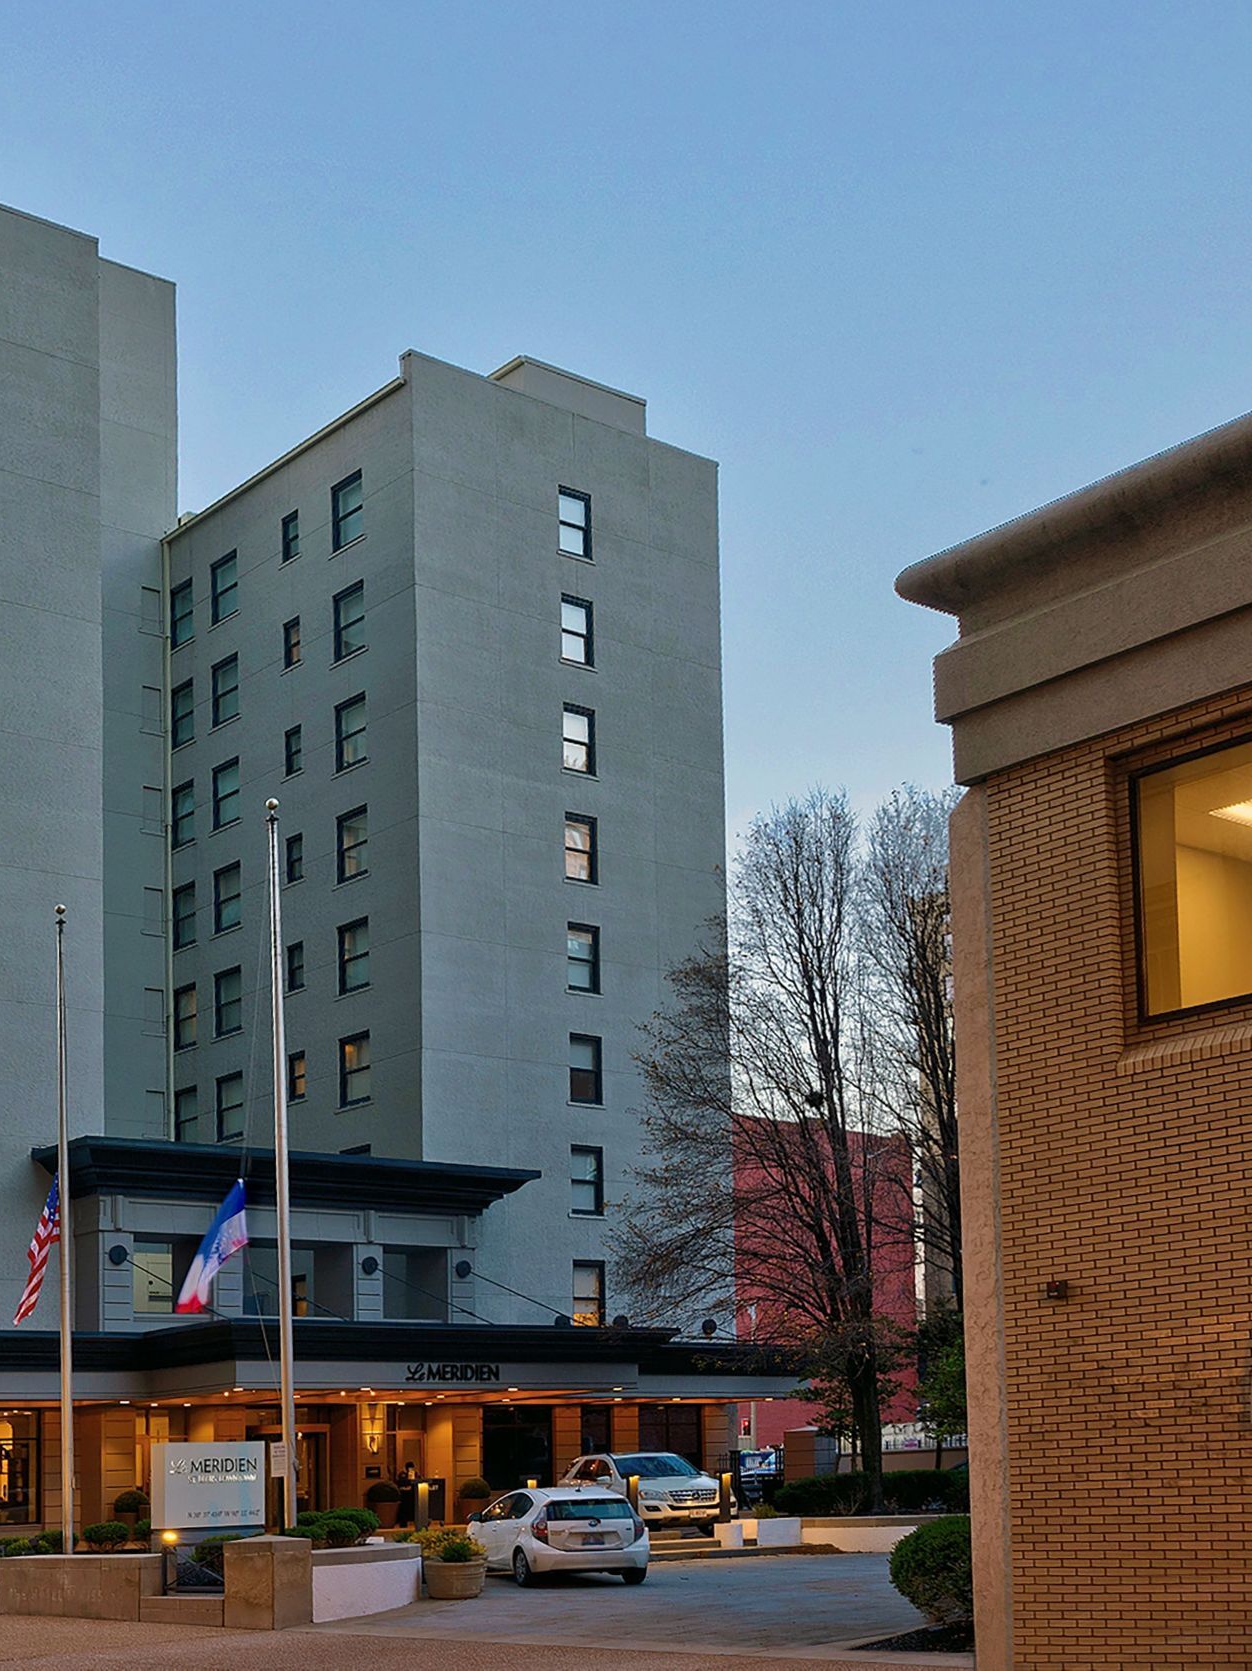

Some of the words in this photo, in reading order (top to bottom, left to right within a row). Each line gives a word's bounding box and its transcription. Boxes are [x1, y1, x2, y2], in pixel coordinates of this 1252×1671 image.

[405, 1362, 426, 1382] Le
[427, 1363, 500, 1381] MERIDIEN
[190, 1457, 258, 1474] MERIDIEN
